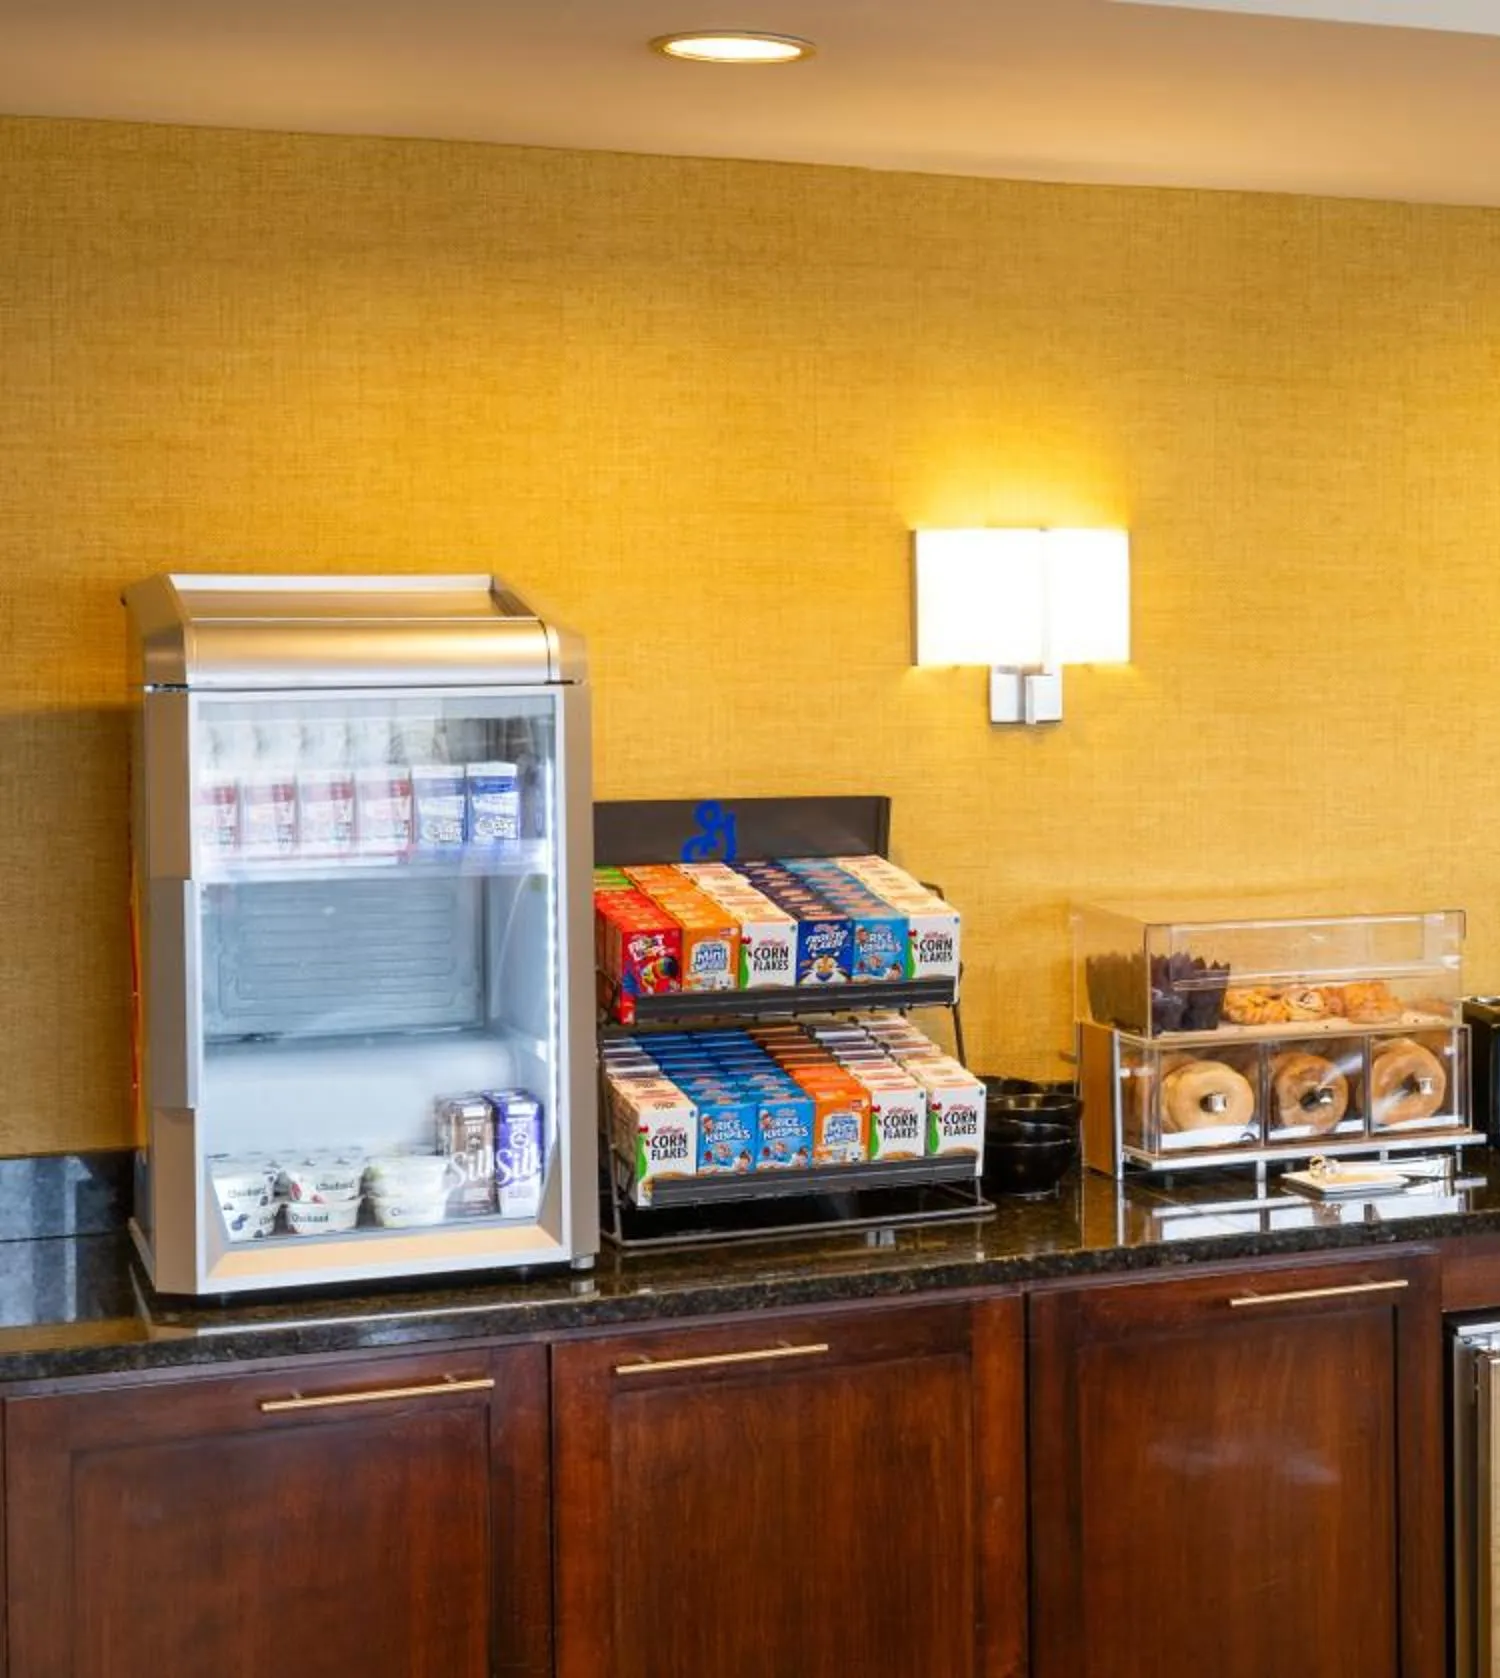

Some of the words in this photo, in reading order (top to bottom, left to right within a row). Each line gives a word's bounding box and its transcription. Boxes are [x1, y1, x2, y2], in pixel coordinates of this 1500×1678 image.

[919, 938, 953, 952] CORN
[753, 946, 789, 961] CORN
[919, 951, 953, 963] FLAKES
[753, 959, 789, 971] FLAKES
[883, 1114, 918, 1129] CORN
[943, 1110, 977, 1125] CORN
[883, 1127, 918, 1140] FLAKES
[943, 1123, 977, 1137] FLAKES
[651, 1132, 688, 1149] CORN
[651, 1147, 688, 1161] FLAKES
